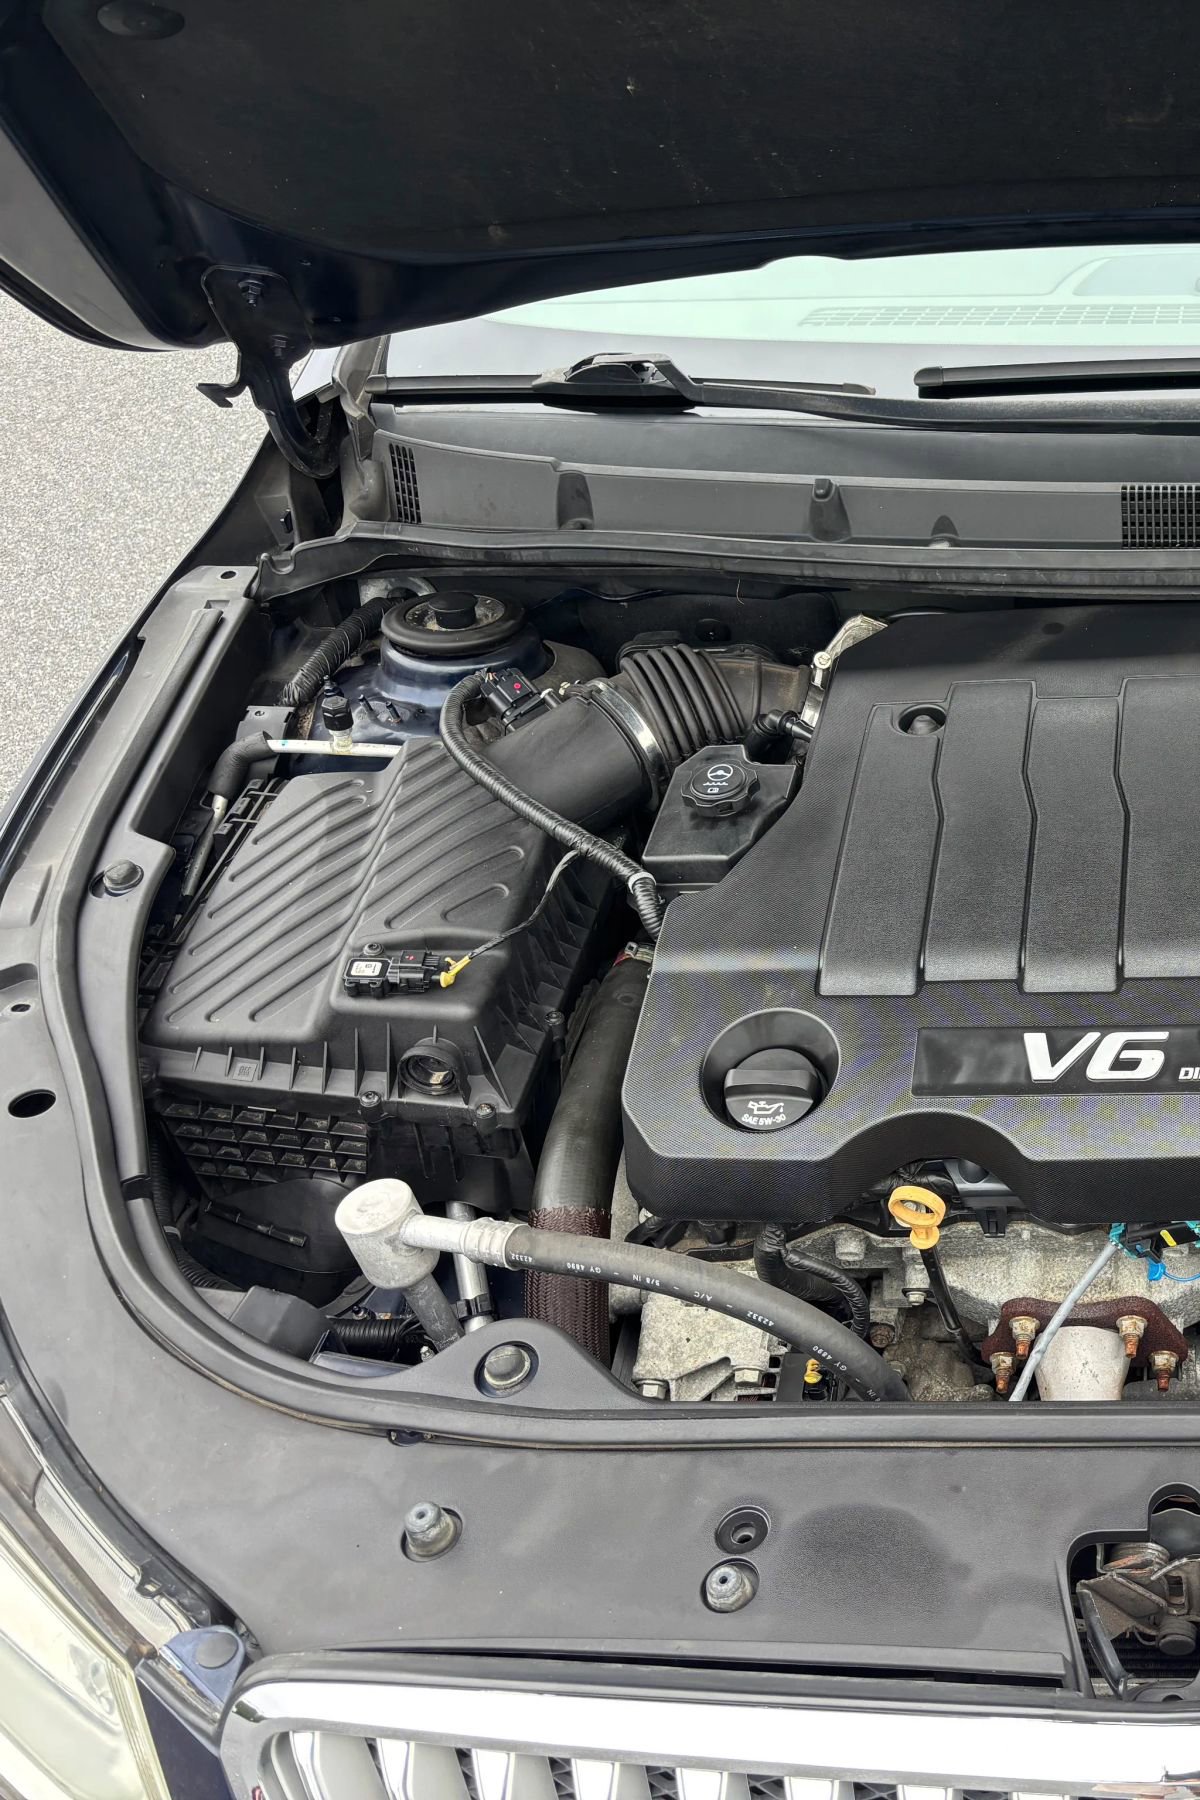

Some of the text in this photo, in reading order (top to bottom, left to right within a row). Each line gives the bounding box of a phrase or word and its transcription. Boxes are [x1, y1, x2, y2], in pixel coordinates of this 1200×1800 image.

[1023, 1031, 1170, 1083] V6
[741, 1113, 787, 1126] SAE 5W-30
[589, 1266, 601, 1274] GY
[632, 1274, 641, 1282] IN
[645, 1277, 660, 1286] 5/8
[692, 1291, 713, 1302] A/C
[745, 1310, 775, 1327] 42332
[812, 1345, 833, 1361] 4890
[833, 1361, 847, 1371] GY
